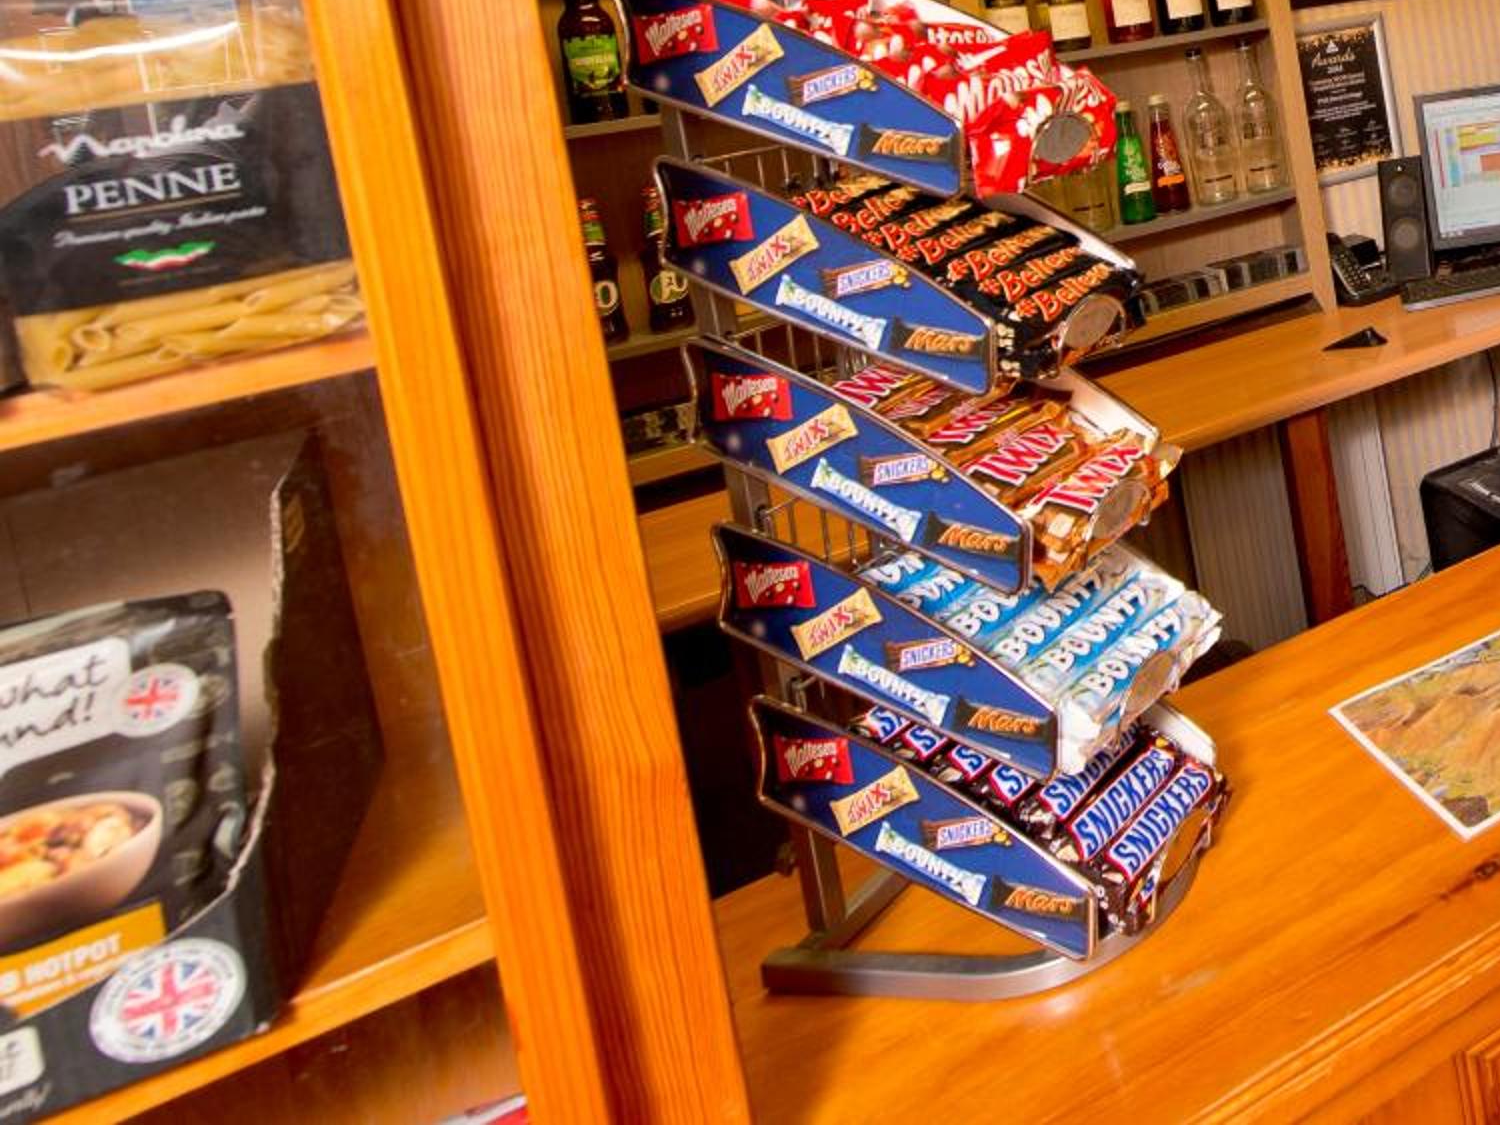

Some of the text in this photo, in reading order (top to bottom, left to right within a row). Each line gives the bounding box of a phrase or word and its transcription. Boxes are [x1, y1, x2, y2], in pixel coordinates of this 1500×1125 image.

[806, 65, 858, 98] SNICKERS
[38, 115, 245, 163] Napolina
[758, 96, 831, 139] BOUNTY
[63, 162, 242, 215] PENNE
[793, 289, 866, 333] BOUNTY
[876, 455, 929, 480] SNICKERS
[960, 424, 1076, 486] TWIX
[1024, 443, 1144, 514] TWIX
[830, 476, 899, 526] BOUNTY
[1048, 582, 1147, 673] BOUNTY
[902, 641, 955, 665] SNICKERS
[857, 661, 929, 710] BOUNTY
[1073, 748, 1175, 859] SNICKERS
[1112, 766, 1211, 871] SNICKERS
[938, 819, 994, 844] SNICKERS
[895, 838, 964, 888] BOUNTY
